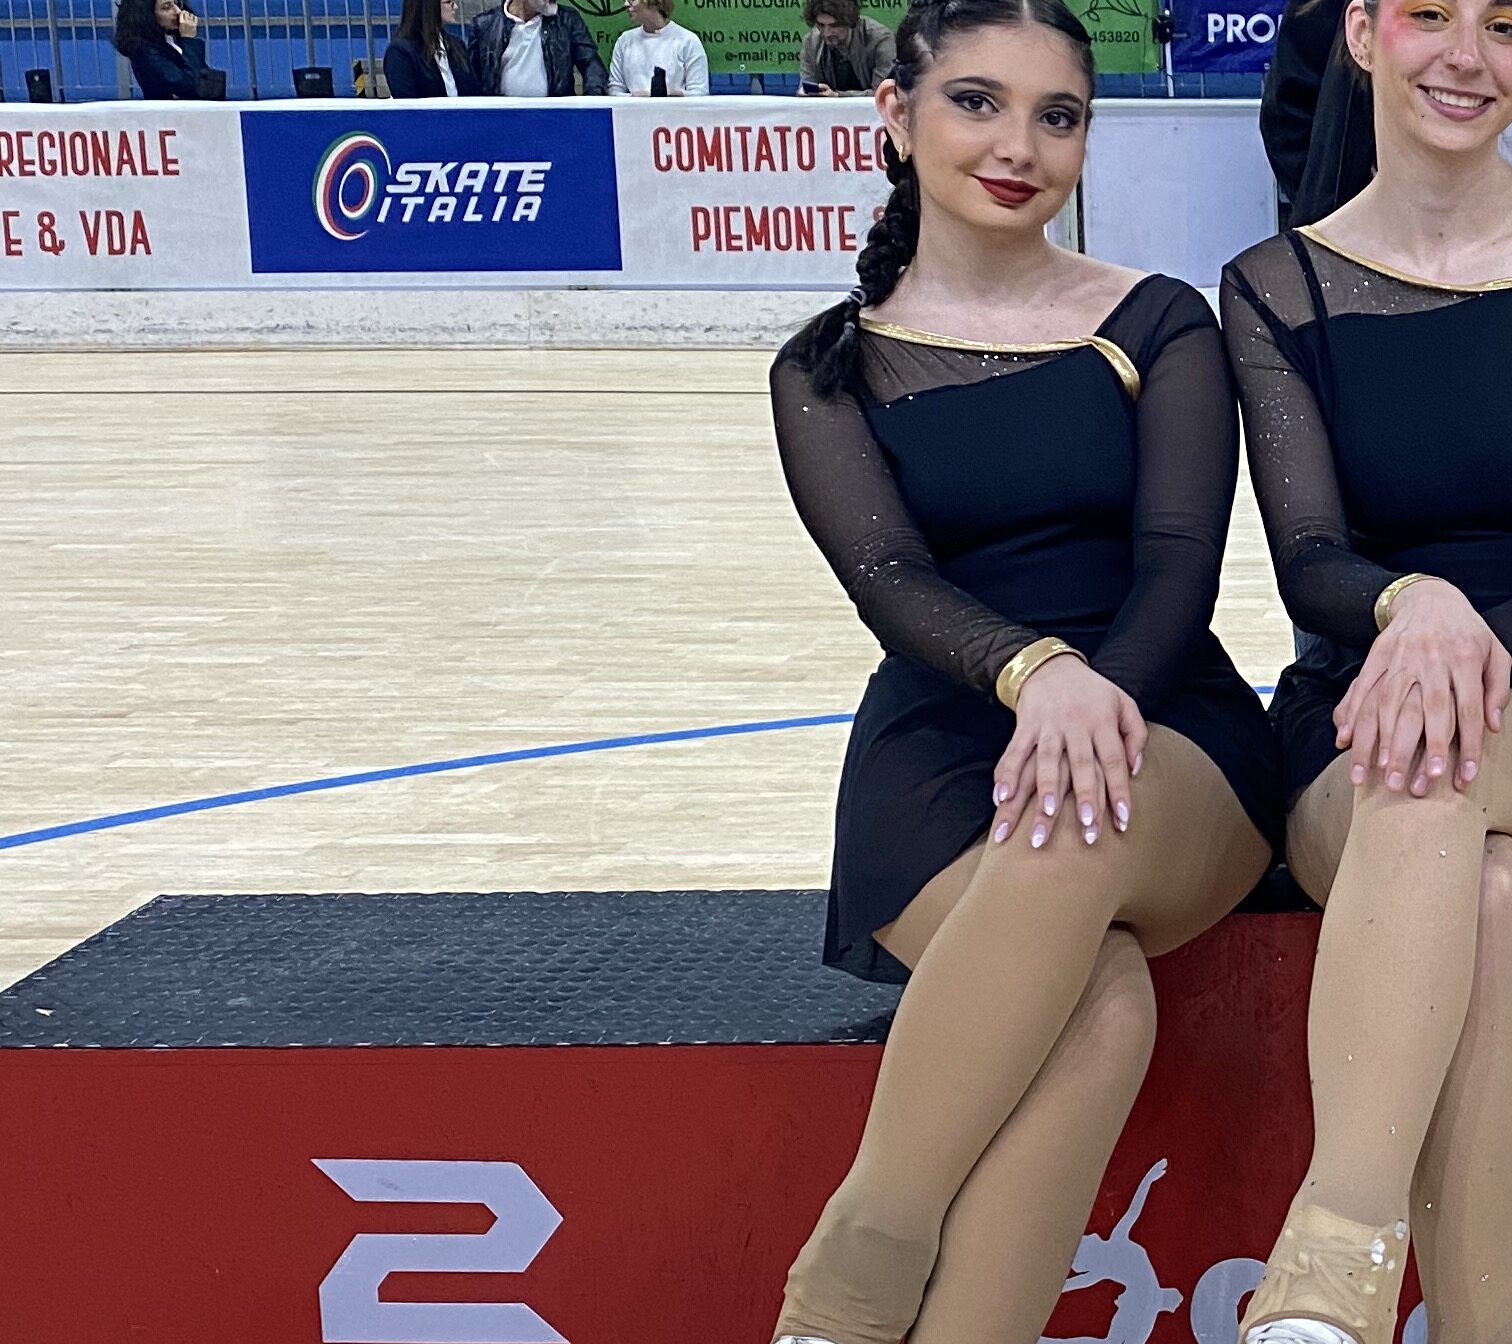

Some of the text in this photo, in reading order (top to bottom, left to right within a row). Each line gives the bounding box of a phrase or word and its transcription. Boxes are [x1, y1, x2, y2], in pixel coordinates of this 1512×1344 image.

[737, 30, 803, 44] NOVARA
[1206, 12, 1284, 43] PRO
[724, 49, 774, 62] e-mail:
[0, 129, 181, 177] REGIONALE
[652, 125, 816, 172] COMITATO
[385, 161, 552, 194] SKATE
[376, 195, 542, 223] ITALIA
[690, 205, 858, 252] PIEMONTE
[36, 210, 66, 257] &
[78, 209, 152, 256] VDA
[310, 1158, 572, 1344] 2
